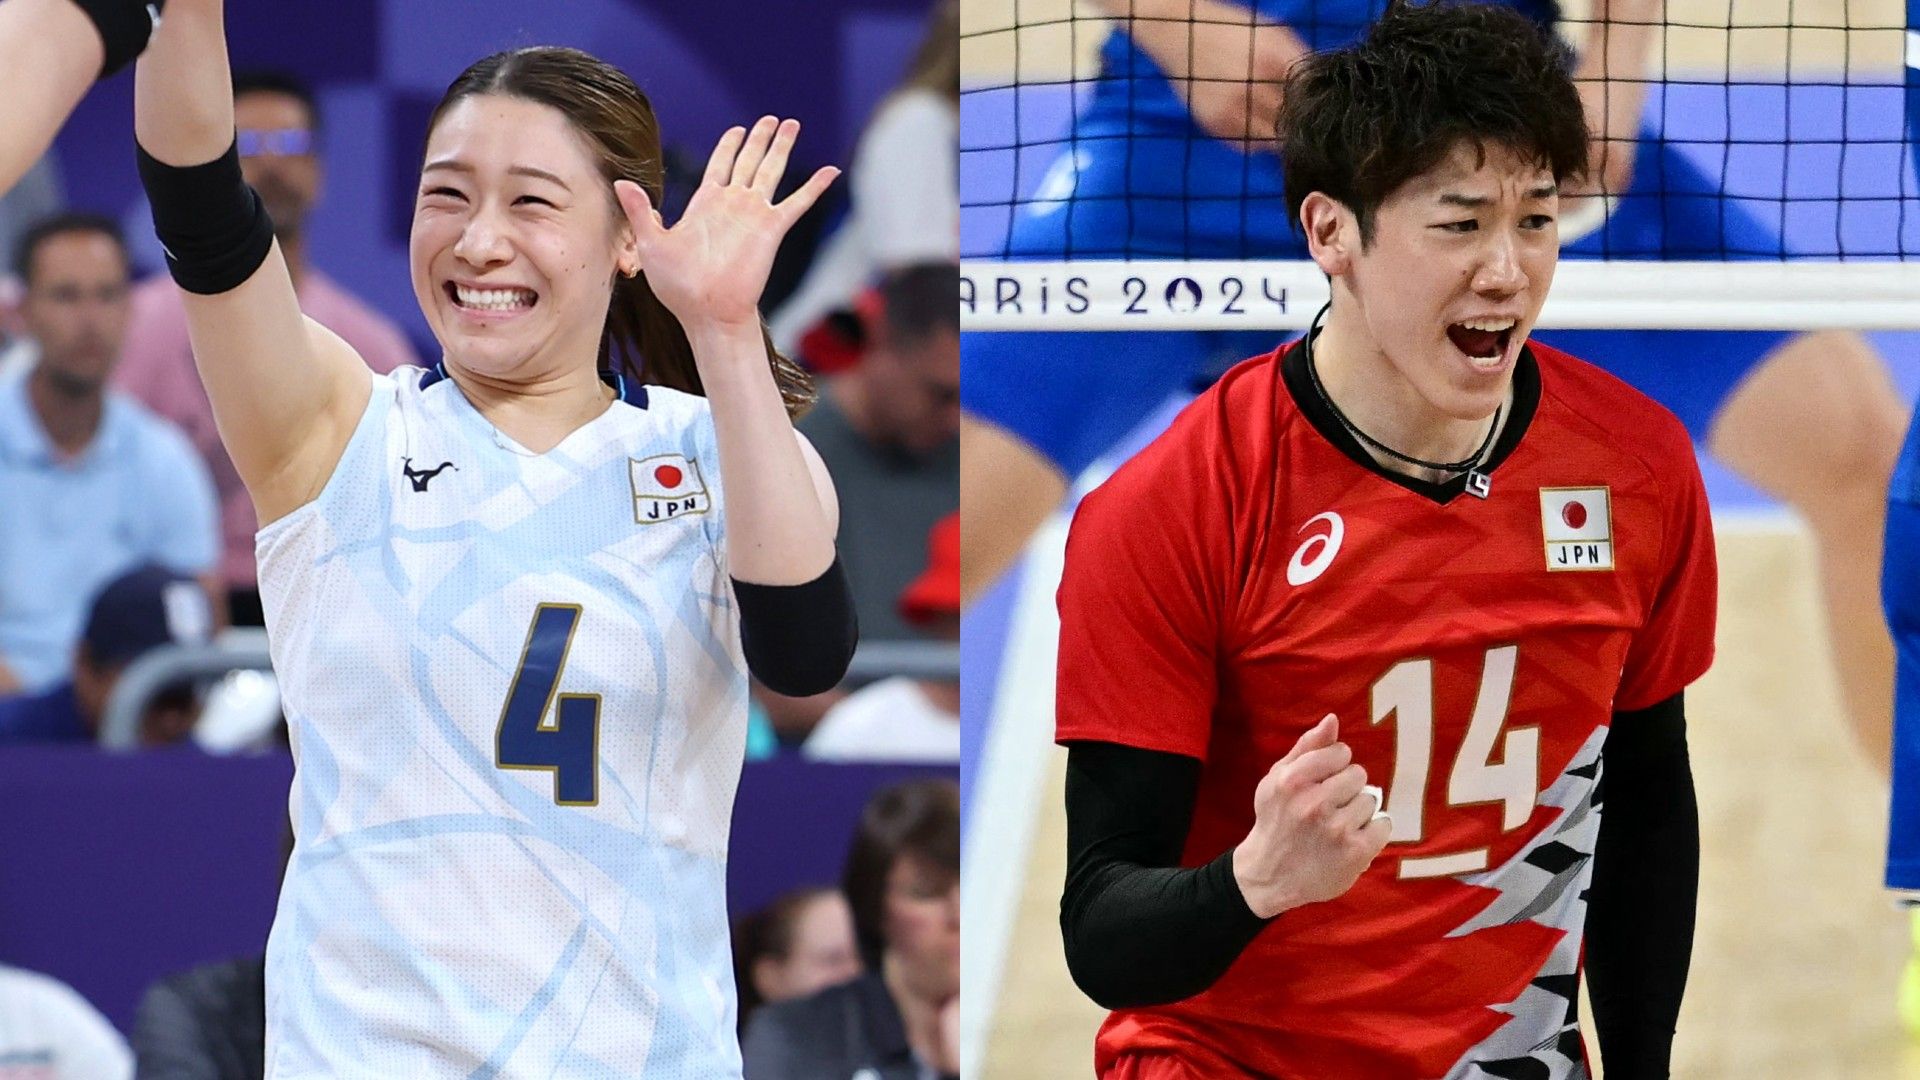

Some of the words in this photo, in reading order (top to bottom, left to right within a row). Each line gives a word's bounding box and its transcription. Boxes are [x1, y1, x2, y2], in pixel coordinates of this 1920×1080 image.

[647, 498, 696, 519] JPN
[1558, 545, 1599, 564] JPN
[495, 603, 602, 806] 4
[1369, 643, 1542, 844] 14
